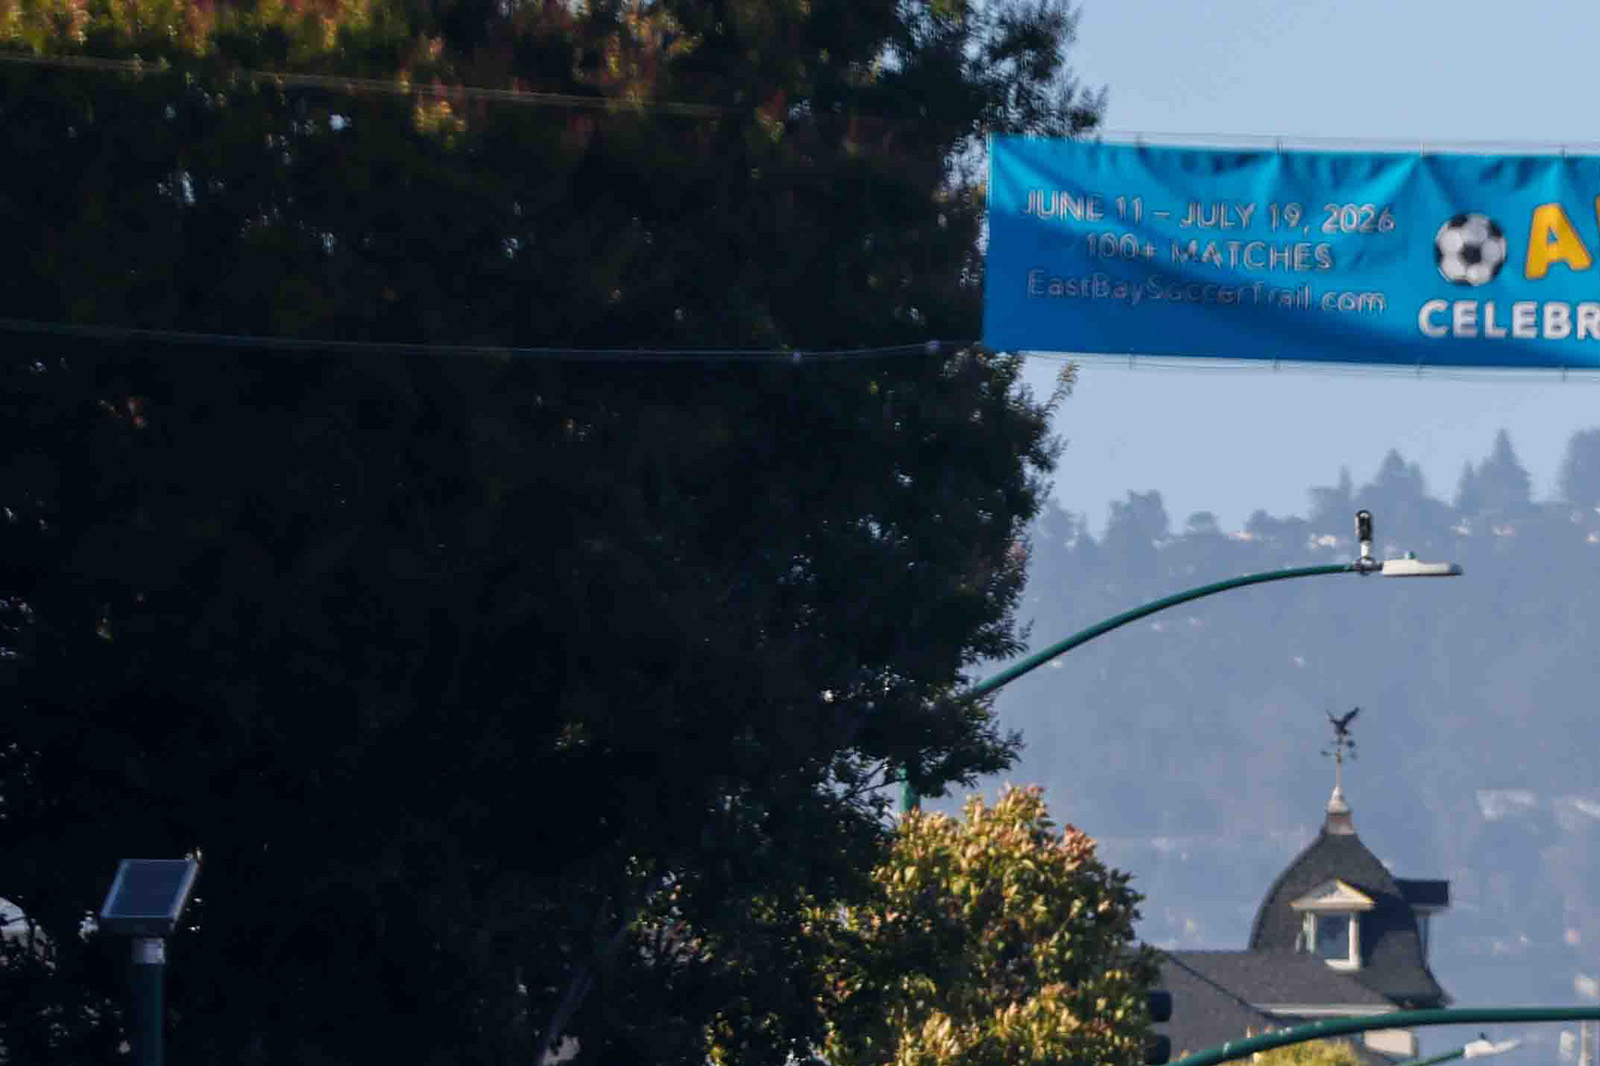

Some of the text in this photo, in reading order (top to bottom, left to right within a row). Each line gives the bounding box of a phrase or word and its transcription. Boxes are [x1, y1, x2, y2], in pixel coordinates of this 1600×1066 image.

[1024, 190, 1104, 222] JUNE
[1115, 196, 1145, 221] 11
[1180, 202, 1256, 230] JULY
[1268, 204, 1311, 235] 19,
[1322, 204, 1395, 232] 2026
[1087, 233, 1332, 270] 100+ MATCHES
